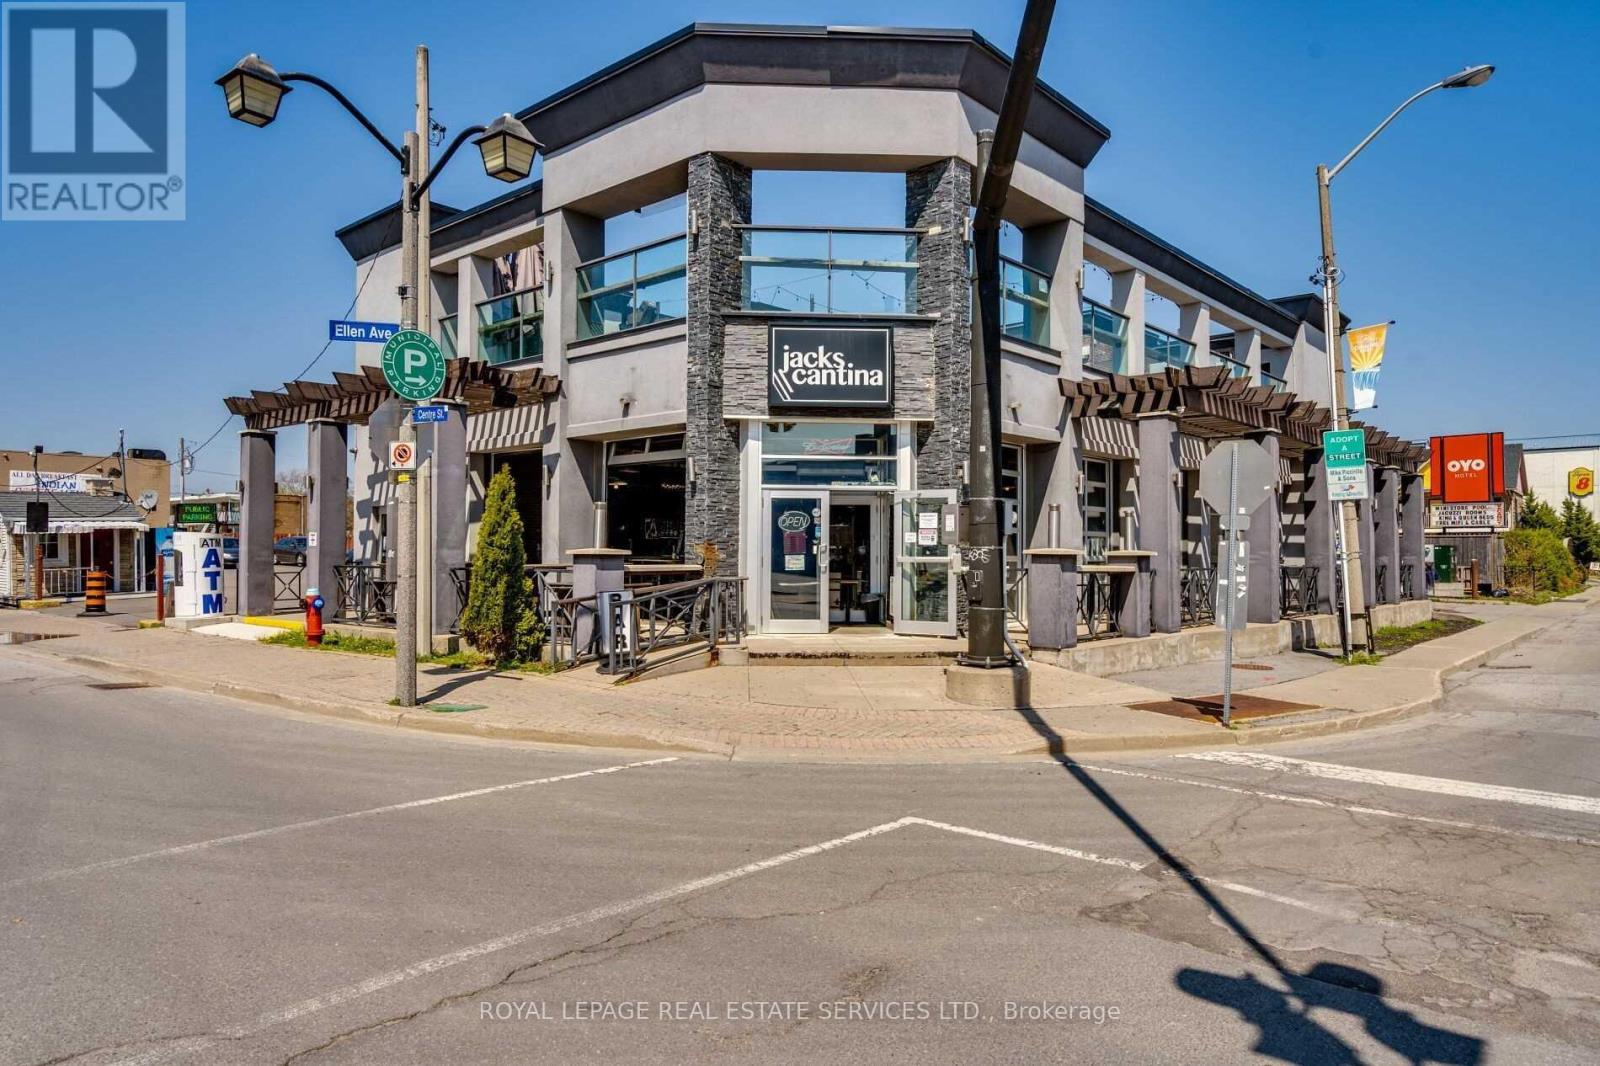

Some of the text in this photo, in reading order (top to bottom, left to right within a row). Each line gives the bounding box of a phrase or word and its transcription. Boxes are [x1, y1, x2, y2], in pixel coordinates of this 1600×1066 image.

[335, 324, 392, 340] Ellen Ave
[384, 332, 443, 368] MUNICIPAL
[404, 348, 428, 374] P
[781, 344, 846, 374] jacks
[791, 362, 884, 386] cantina
[386, 369, 442, 398] PARKING
[417, 408, 436, 420] Centre
[1330, 435, 1359, 443] ADOPT
[1328, 452, 1361, 461] STREET
[1447, 458, 1485, 473] OYO
[1576, 476, 1590, 490] 8
[181, 513, 214, 521] PARKING
[782, 515, 807, 528] OPEN
[201, 538, 221, 548] ATM
[202, 548, 224, 615] ATM
